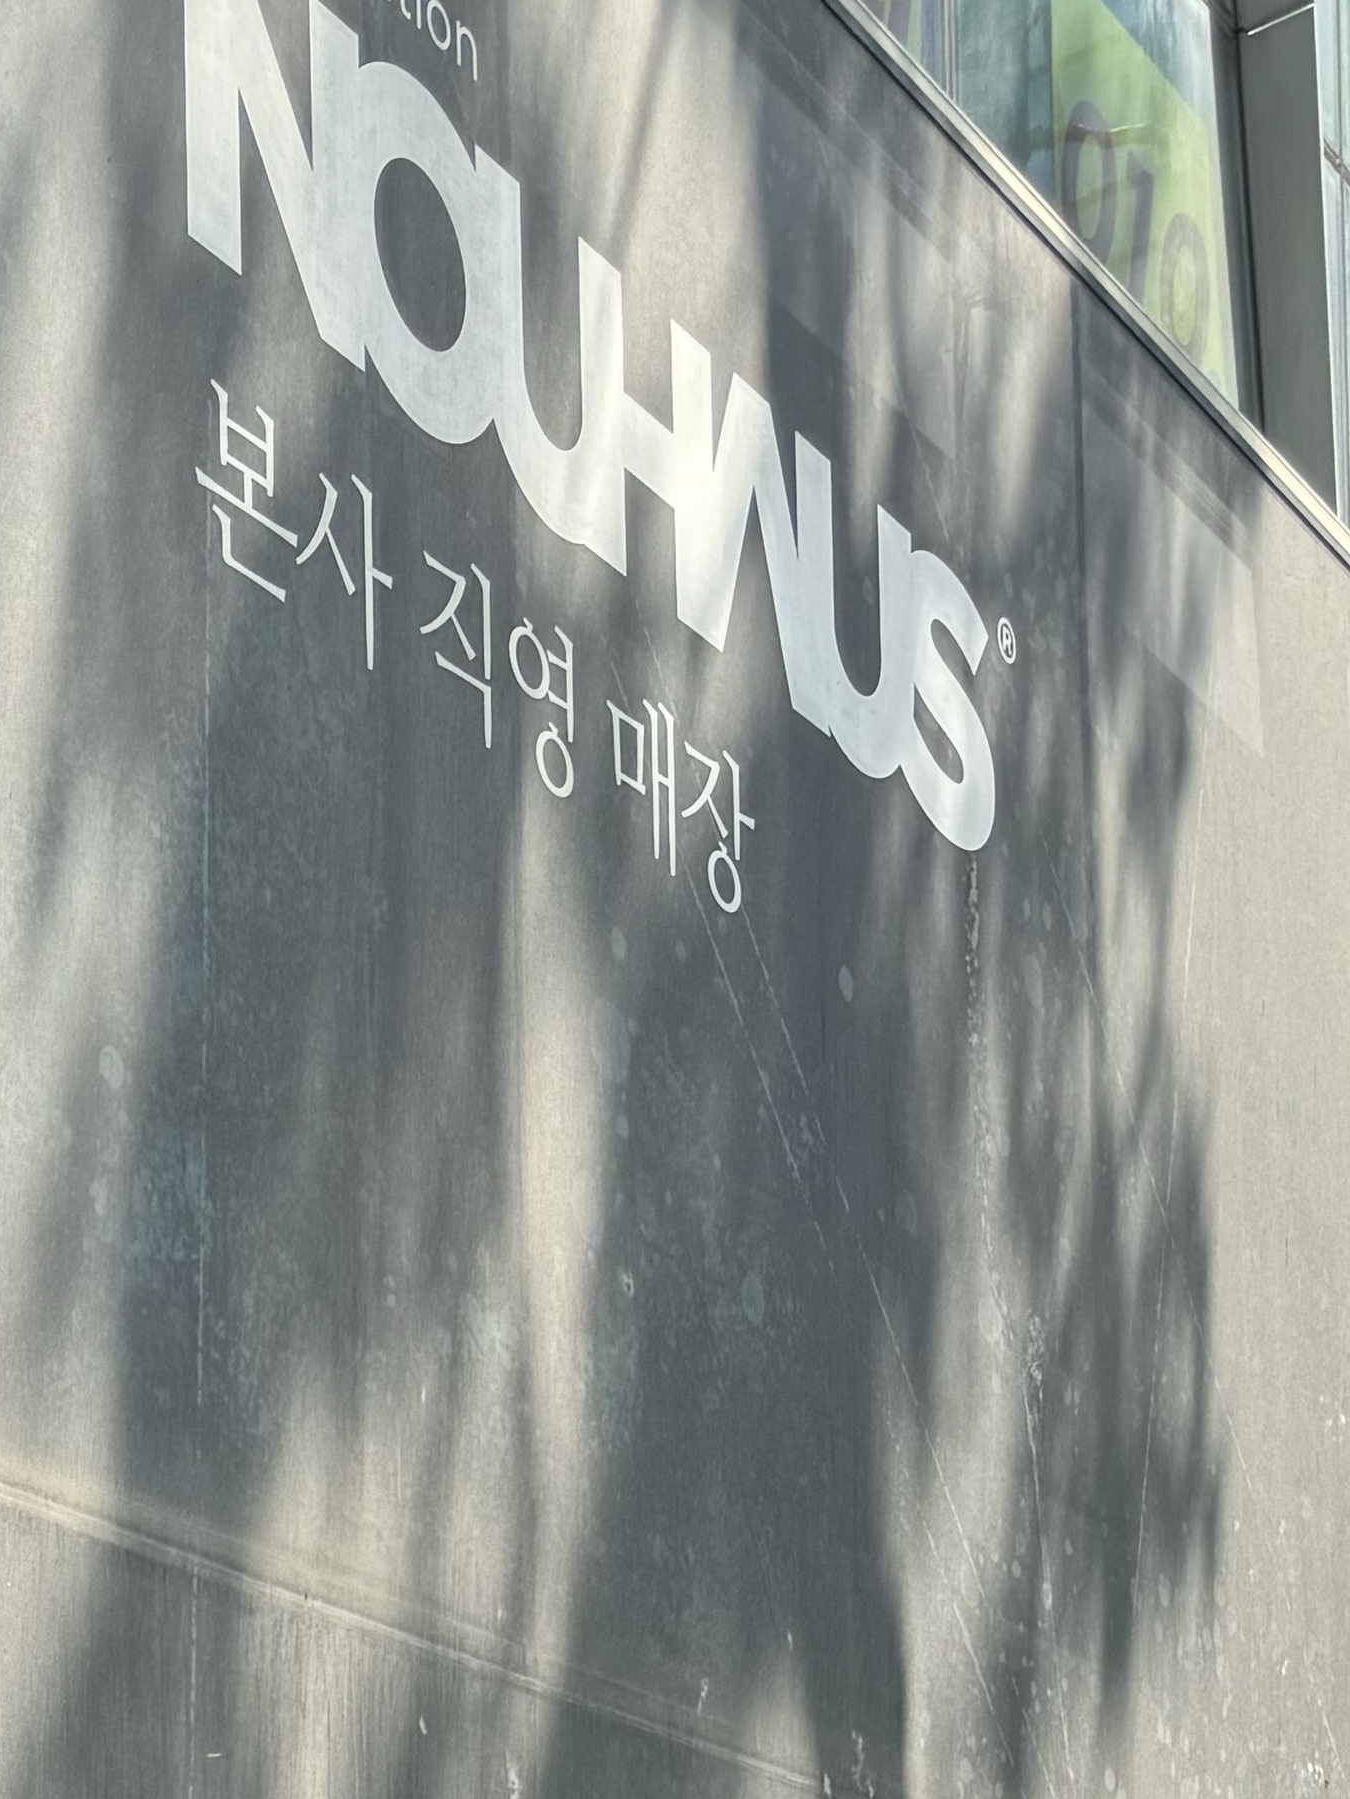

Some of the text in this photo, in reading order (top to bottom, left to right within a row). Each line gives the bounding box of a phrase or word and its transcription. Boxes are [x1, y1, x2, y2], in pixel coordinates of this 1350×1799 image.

[183, 0, 995, 851] NOUHAUS
[195, 378, 755, 913] 본사 직영 매장
